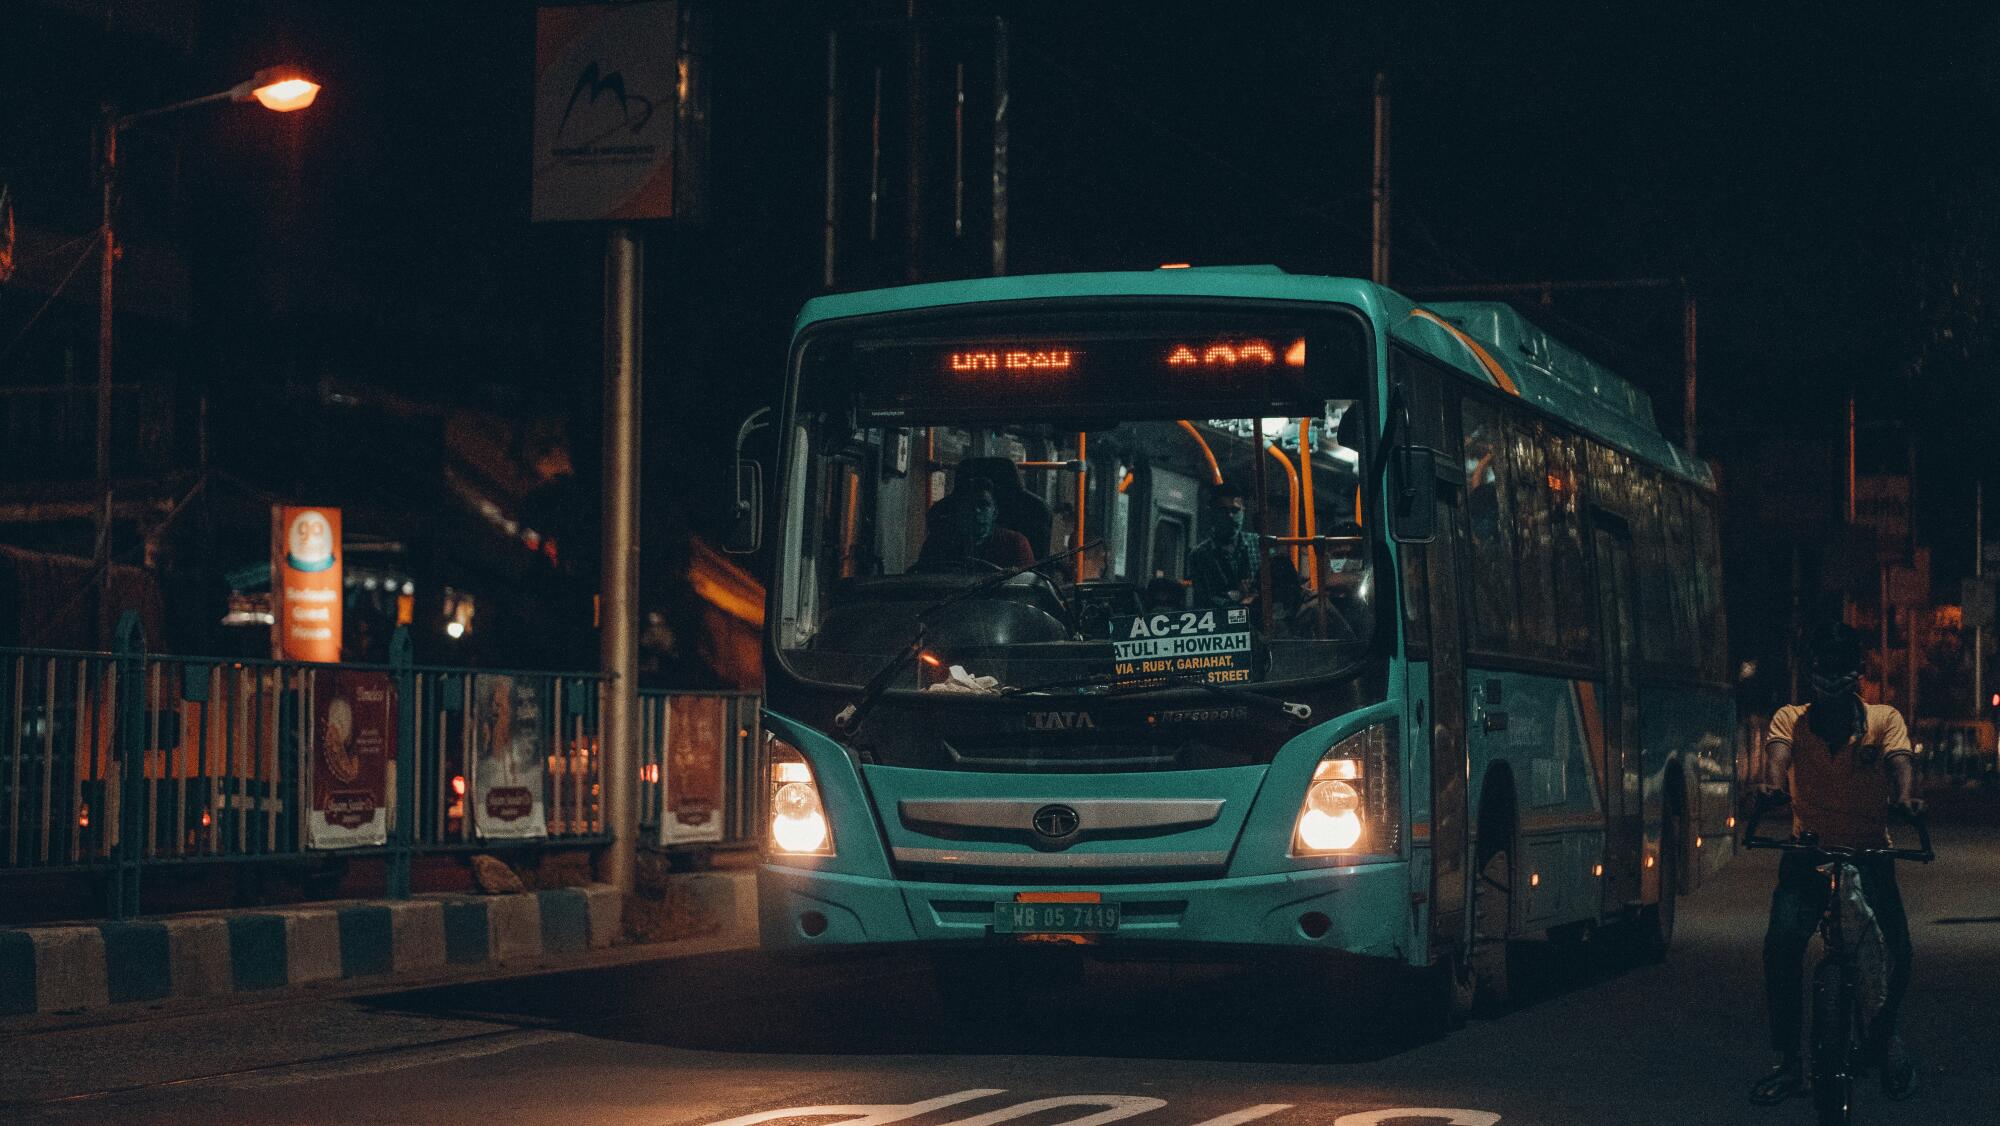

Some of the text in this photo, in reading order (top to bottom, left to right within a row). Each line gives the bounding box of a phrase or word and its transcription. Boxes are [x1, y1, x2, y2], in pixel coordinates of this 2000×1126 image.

[1129, 611, 1216, 638] AC-24
[1173, 635, 1247, 653] HOWRAH
[1115, 663, 1134, 675] VIA
[1142, 660, 1174, 673] RUBY,
[1176, 655, 1234, 670] GARIAHAT,
[1207, 669, 1249, 683] STREET
[1031, 711, 1094, 729] TATA
[1013, 908, 1034, 927] WB
[1044, 908, 1065, 927] 05
